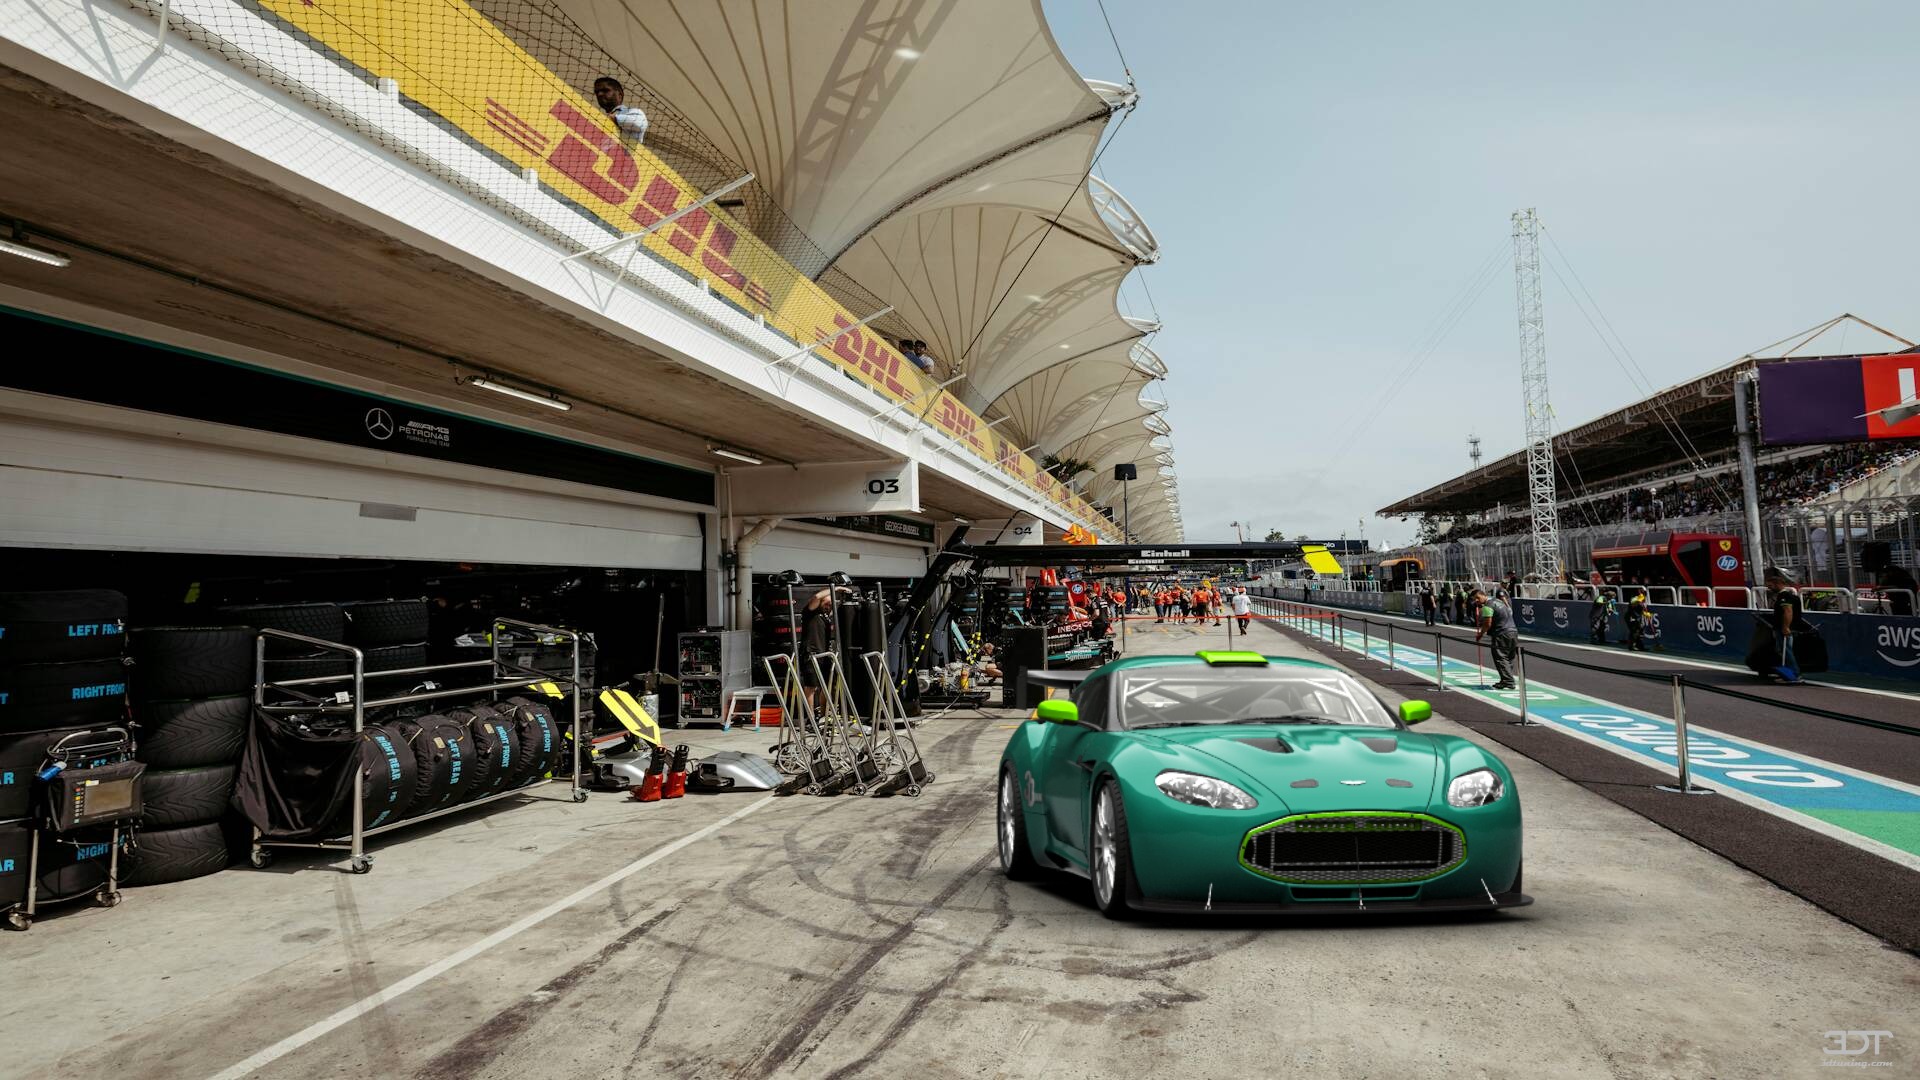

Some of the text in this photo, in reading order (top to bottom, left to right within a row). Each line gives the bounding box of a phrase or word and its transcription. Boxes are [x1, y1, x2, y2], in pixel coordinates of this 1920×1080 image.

[546, 98, 747, 291] DHL
[833, 312, 905, 397] DHL
[942, 396, 979, 447] DHL
[398, 425, 450, 442] PETRONAS
[868, 479, 899, 494] 03
[884, 520, 902, 533] GEORGE
[902, 524, 920, 536] RUSSELL
[1014, 526, 1033, 536] 04
[1141, 550, 1190, 558] Einhell
[1720, 555, 1736, 570] hp
[68, 623, 124, 636] LEFT FRO
[1697, 615, 1724, 633] aws
[1877, 625, 1920, 650] aws
[72, 683, 126, 699] RIGHT FRONT
[536, 713, 548, 729] LEFT
[496, 725, 511, 768] RIGHT FRONT
[1561, 712, 1846, 788] aramco
[374, 736, 397, 756] RIGHT
[388, 758, 401, 781] REAR
[448, 738, 462, 784] LEFT REAR
[77, 843, 109, 860] RIGHT
